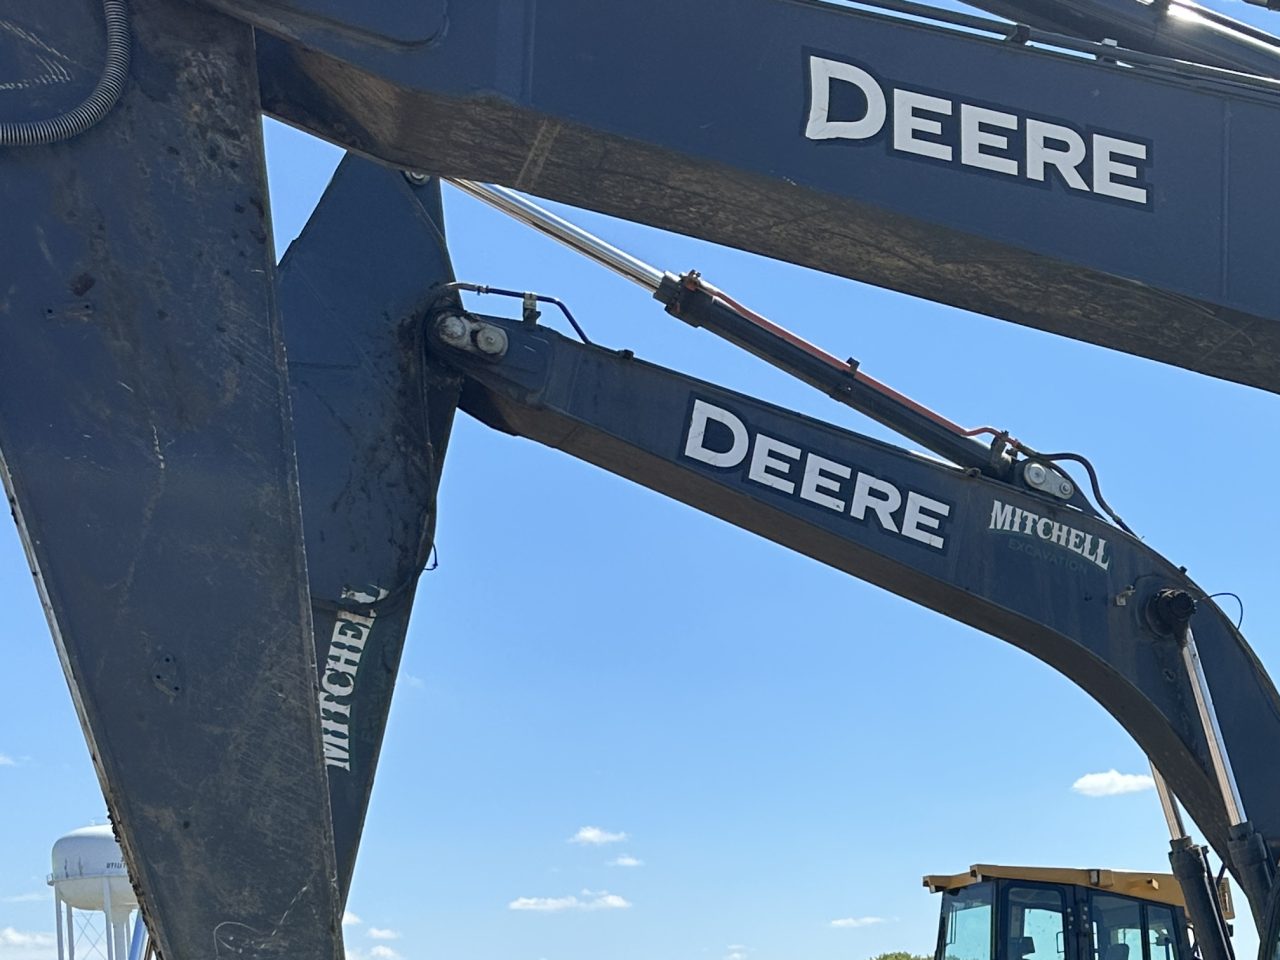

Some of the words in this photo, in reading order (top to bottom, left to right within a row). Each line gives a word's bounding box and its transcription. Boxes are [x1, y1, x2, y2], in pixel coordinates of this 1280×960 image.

[805, 55, 1147, 204] DEERE
[684, 399, 950, 549] DEERE
[988, 500, 1110, 571] MITCHELL
